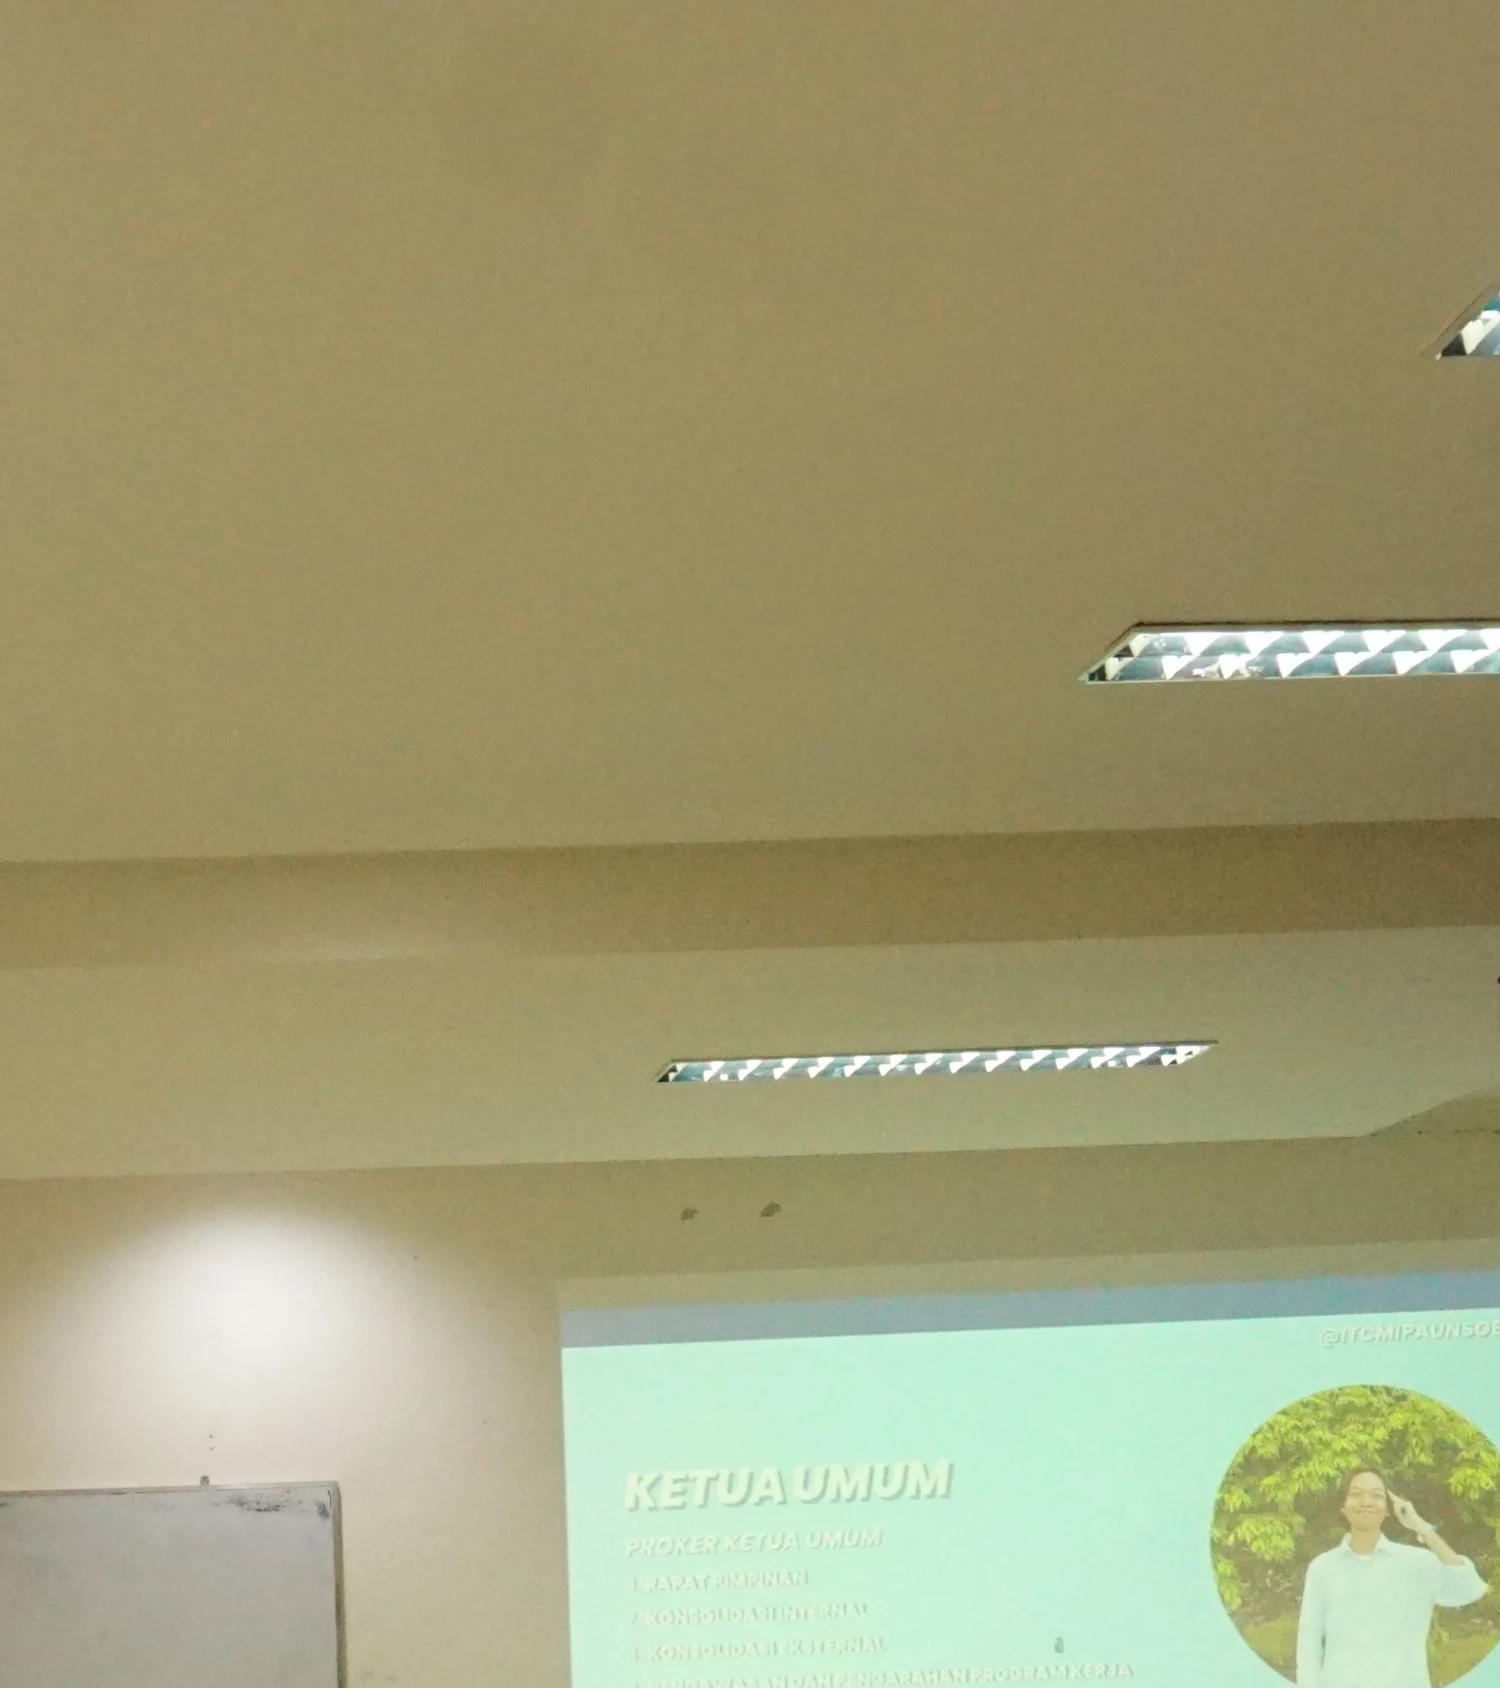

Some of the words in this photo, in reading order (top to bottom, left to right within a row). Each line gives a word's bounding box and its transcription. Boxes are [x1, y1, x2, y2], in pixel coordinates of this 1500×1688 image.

[624, 1466, 787, 1512] KETUA
[792, 1458, 954, 1505] UMUM
[627, 1535, 719, 1558] PROKER
[723, 1532, 801, 1554] KETUA
[806, 1528, 884, 1550] UMUM
[646, 1573, 711, 1592] RAPAT
[713, 1568, 810, 1589] PIMPINAN
[1070, 1660, 1136, 1681] KERJA
